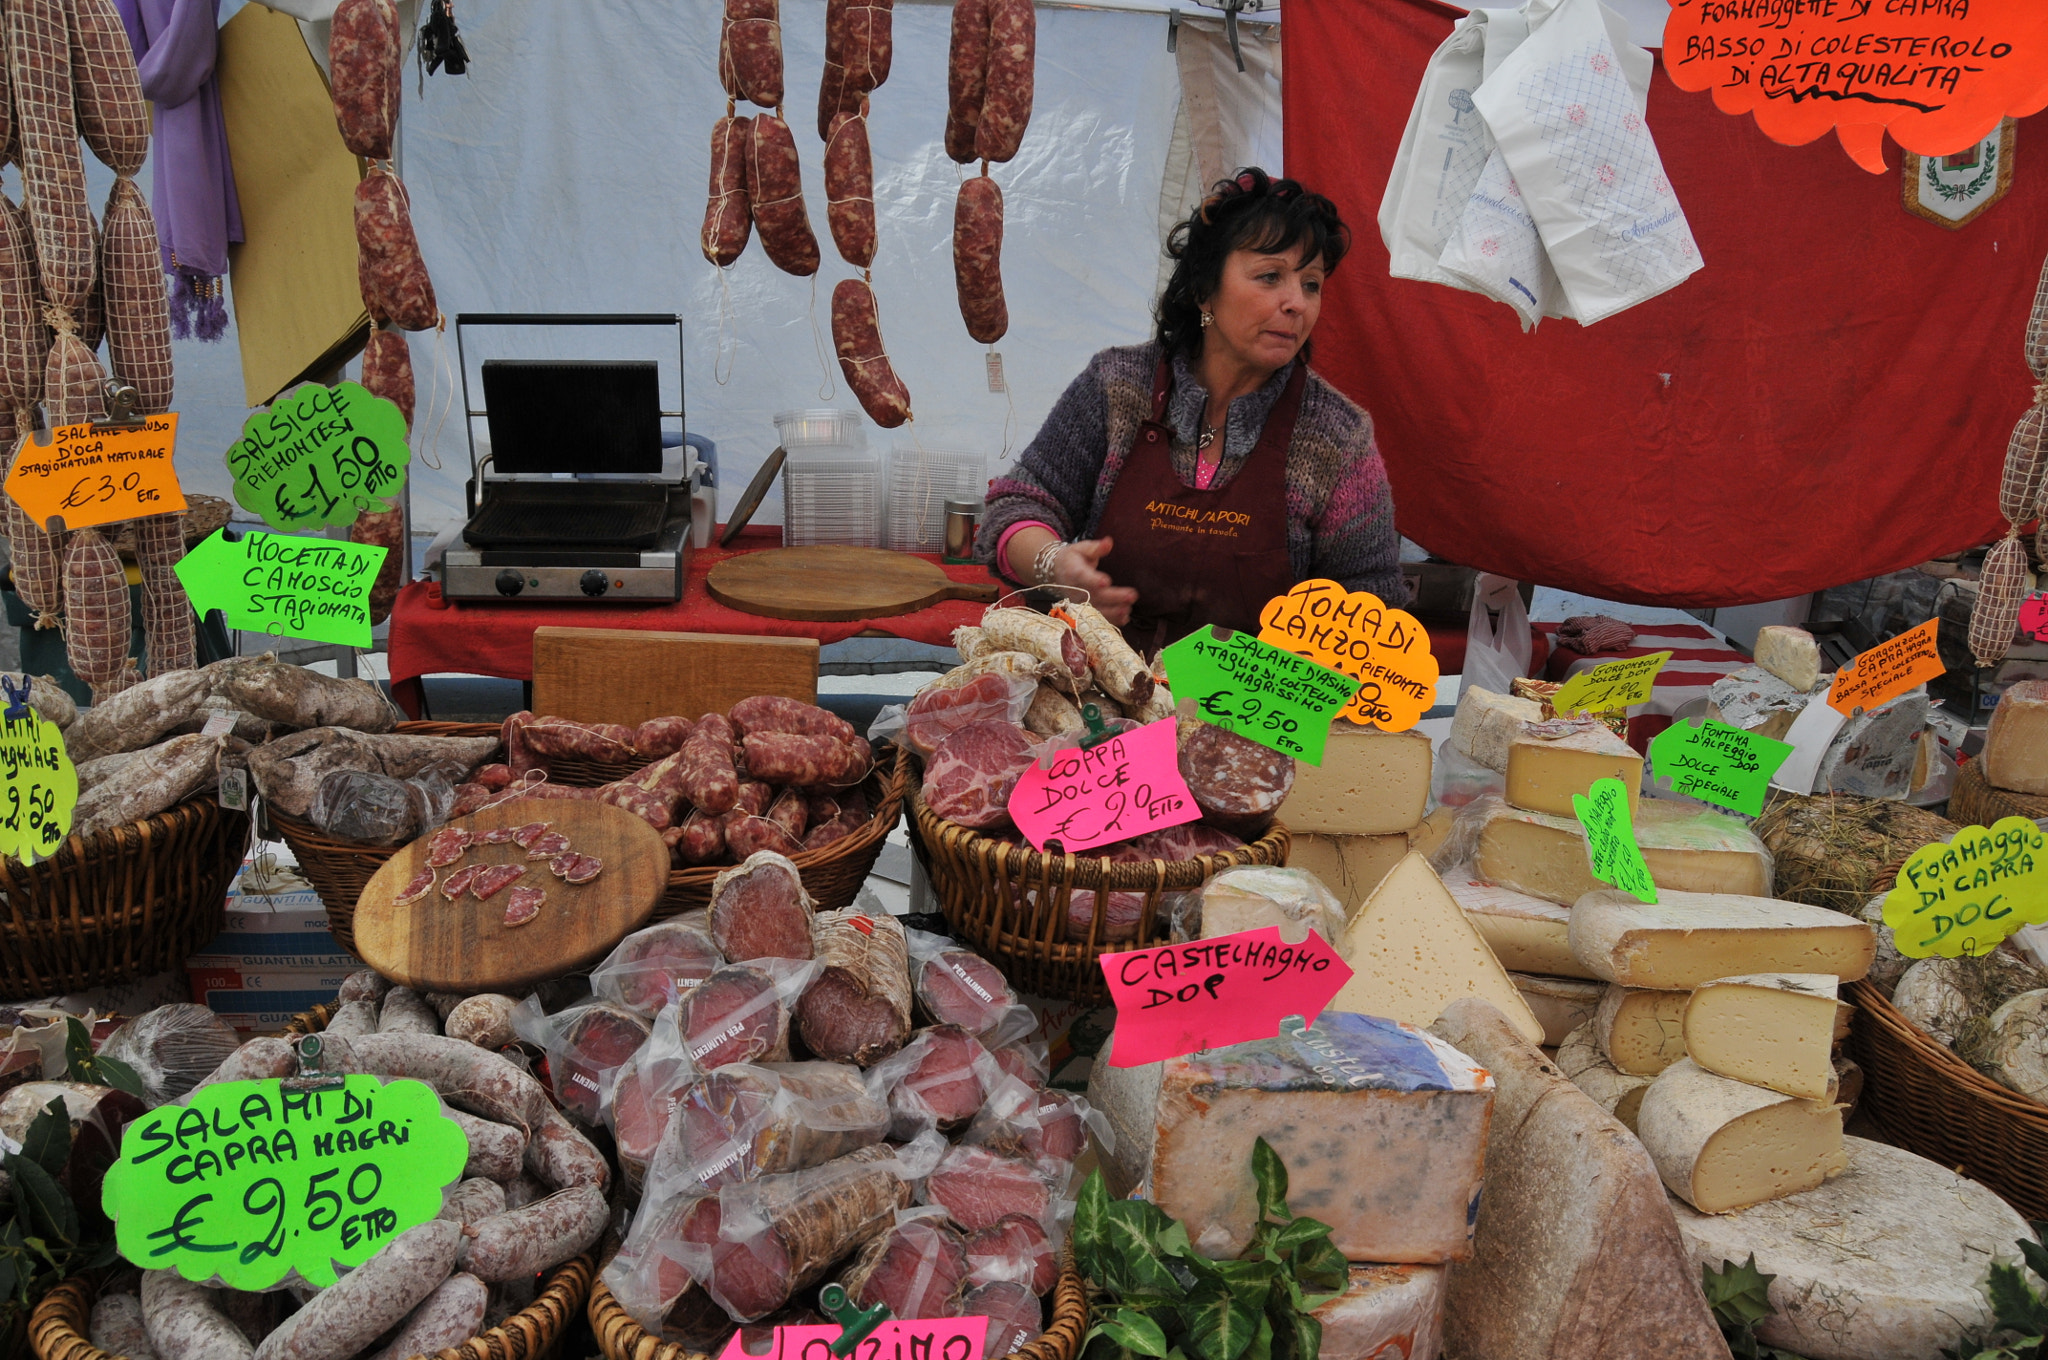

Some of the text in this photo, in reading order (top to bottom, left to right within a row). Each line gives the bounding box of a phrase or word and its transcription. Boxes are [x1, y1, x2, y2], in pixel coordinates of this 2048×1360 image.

[1885, 0, 1969, 20] CAPRA
[1678, 35, 1765, 66] BASSO
[1811, 34, 2012, 59] COLESTEROLO
[1760, 62, 1831, 87] ALTA
[56, 441, 103, 462] D'OCA
[107, 448, 166, 463] NATURALE
[1145, 500, 1251, 526] ANTICHI SAPORI
[1151, 518, 1239, 538] Piemonte in tavola
[1290, 583, 1382, 638] TOMA
[1269, 606, 1370, 661] LANZO
[1229, 635, 1304, 672] SALAME
[1193, 641, 1205, 655] A
[1280, 677, 1338, 705] COLTELLO
[1584, 668, 1651, 687] DOLCE DOP
[1836, 680, 1868, 704] BASSA
[1276, 736, 1304, 752] ETTO
[1048, 739, 1126, 780] COPPA
[1670, 754, 1720, 776] DOLCE
[1729, 760, 1760, 773] DOP
[1034, 762, 1131, 815] DOLCE
[1954, 853, 2034, 892] CAPRA
[243, 895, 297, 905] GUANTI
[1918, 894, 2013, 947] DOC
[243, 956, 297, 966] GUANTI
[300, 956, 315, 965] IN
[205, 977, 227, 988] 100
[677, 978, 704, 988] MENTI
[952, 963, 994, 1004] PER ALIMENTI
[1141, 974, 1226, 1010] DOP
[259, 1013, 293, 1024] GUA
[691, 1022, 745, 1061] PER ALIMENTI
[572, 1072, 600, 1094] IMENTI
[1037, 1103, 1058, 1117] LIMENTI
[165, 1128, 298, 1184] CAPRA
[699, 1140, 752, 1183] PER ALIMENTI
[341, 1207, 397, 1250] ETTO
